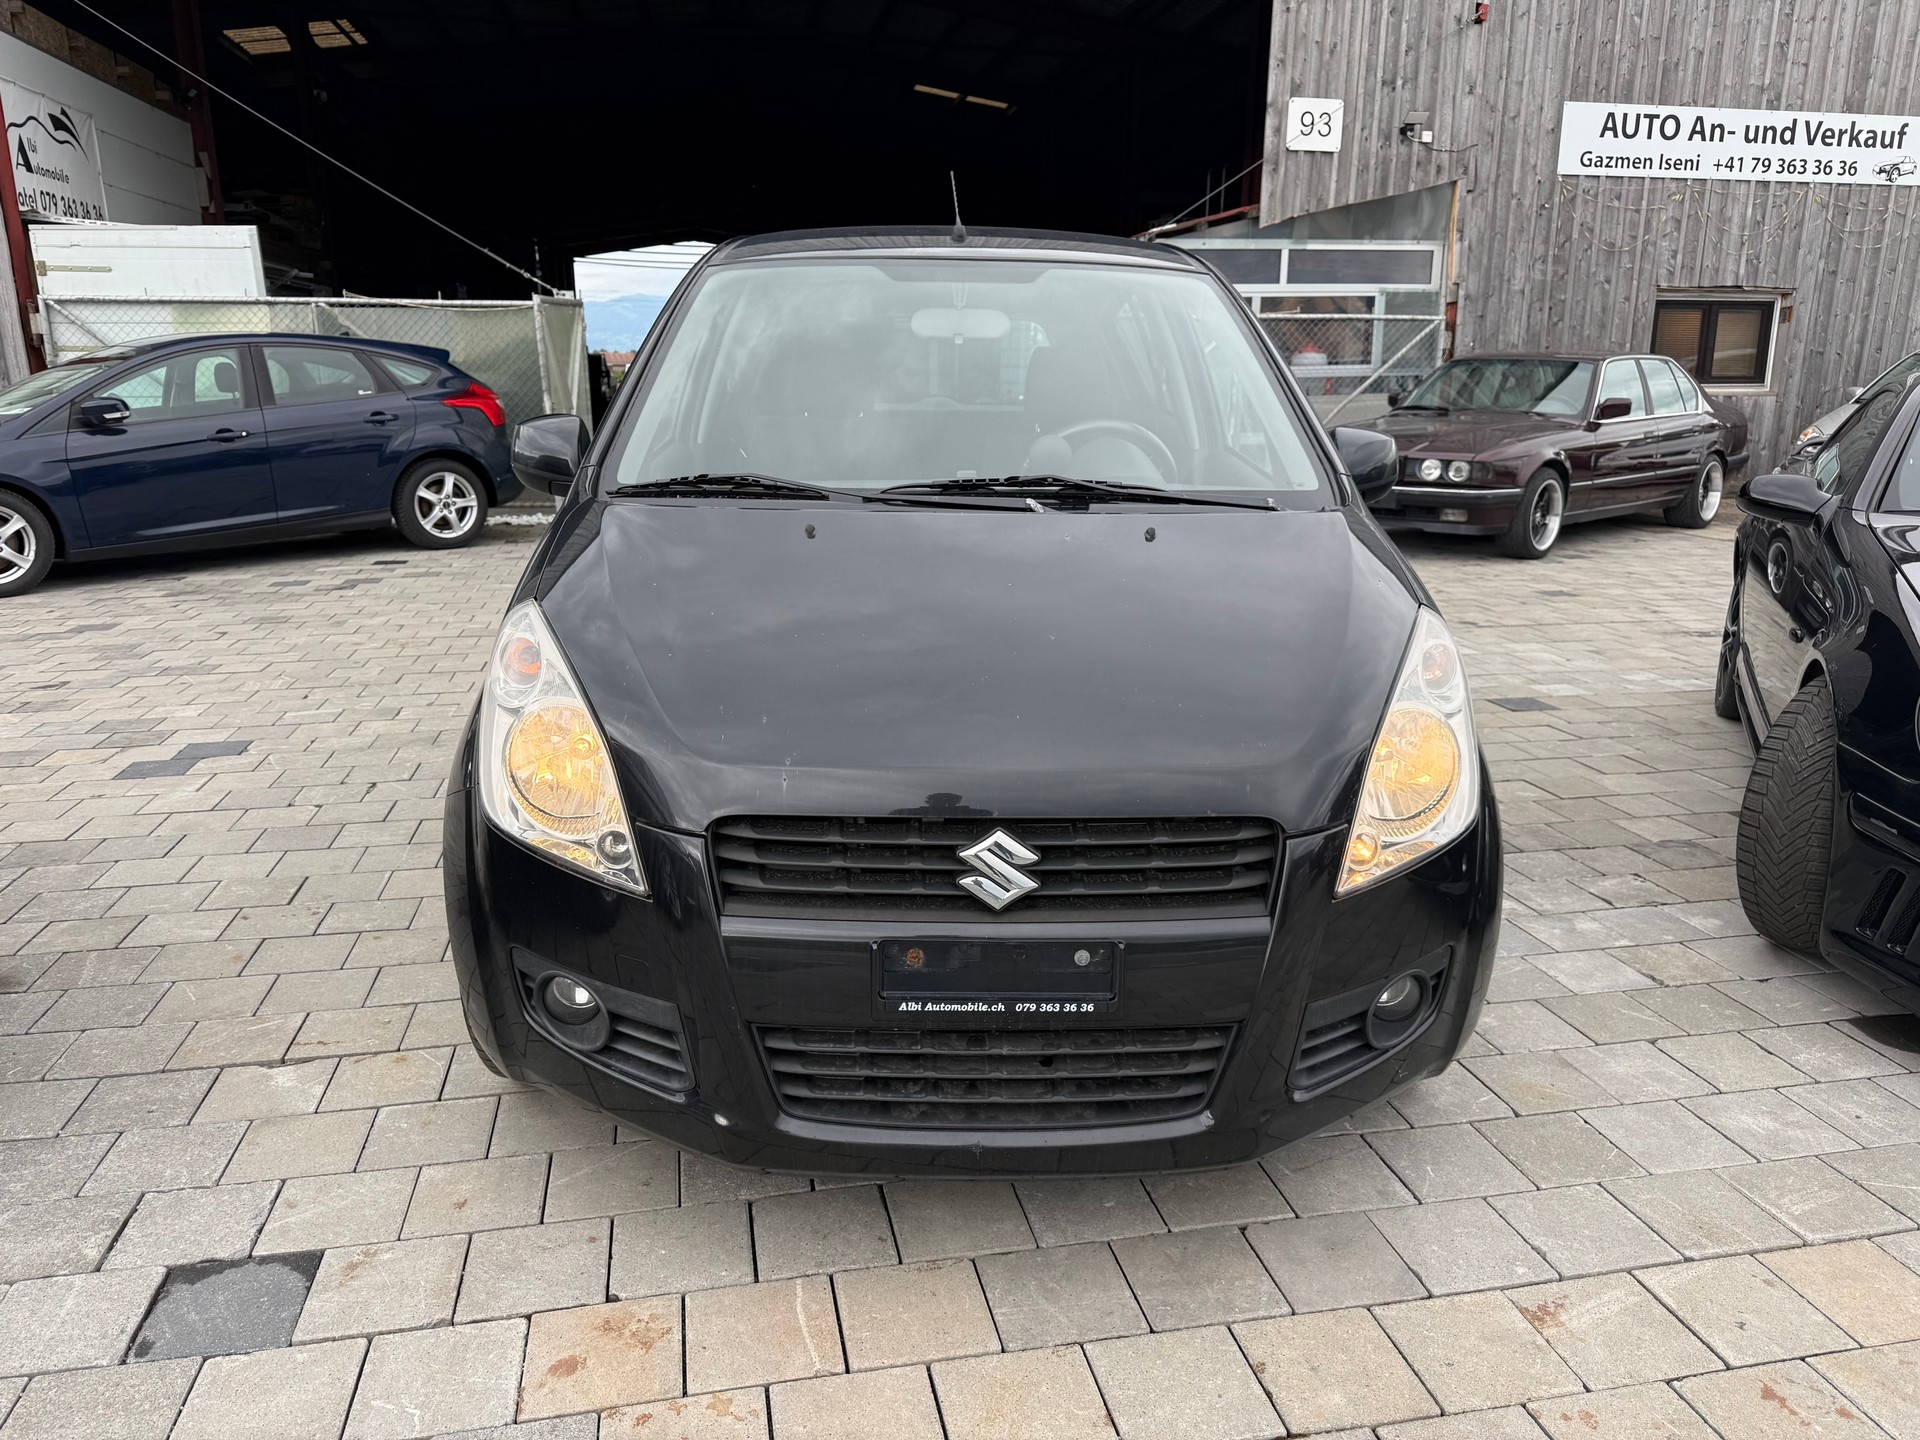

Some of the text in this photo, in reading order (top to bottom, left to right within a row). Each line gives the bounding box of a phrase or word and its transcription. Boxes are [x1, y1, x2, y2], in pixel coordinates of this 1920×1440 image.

[1300, 111, 1332, 137] 93
[1599, 112, 1910, 150] AUTO An- und Verkauf
[1580, 150, 1858, 177] Gazmen Iseni +41 79 363 36 36
[18, 186, 104, 221] atel 079 363 36 36
[898, 1001, 1095, 1012] Albi Automobile.ch 079 363 36 36
